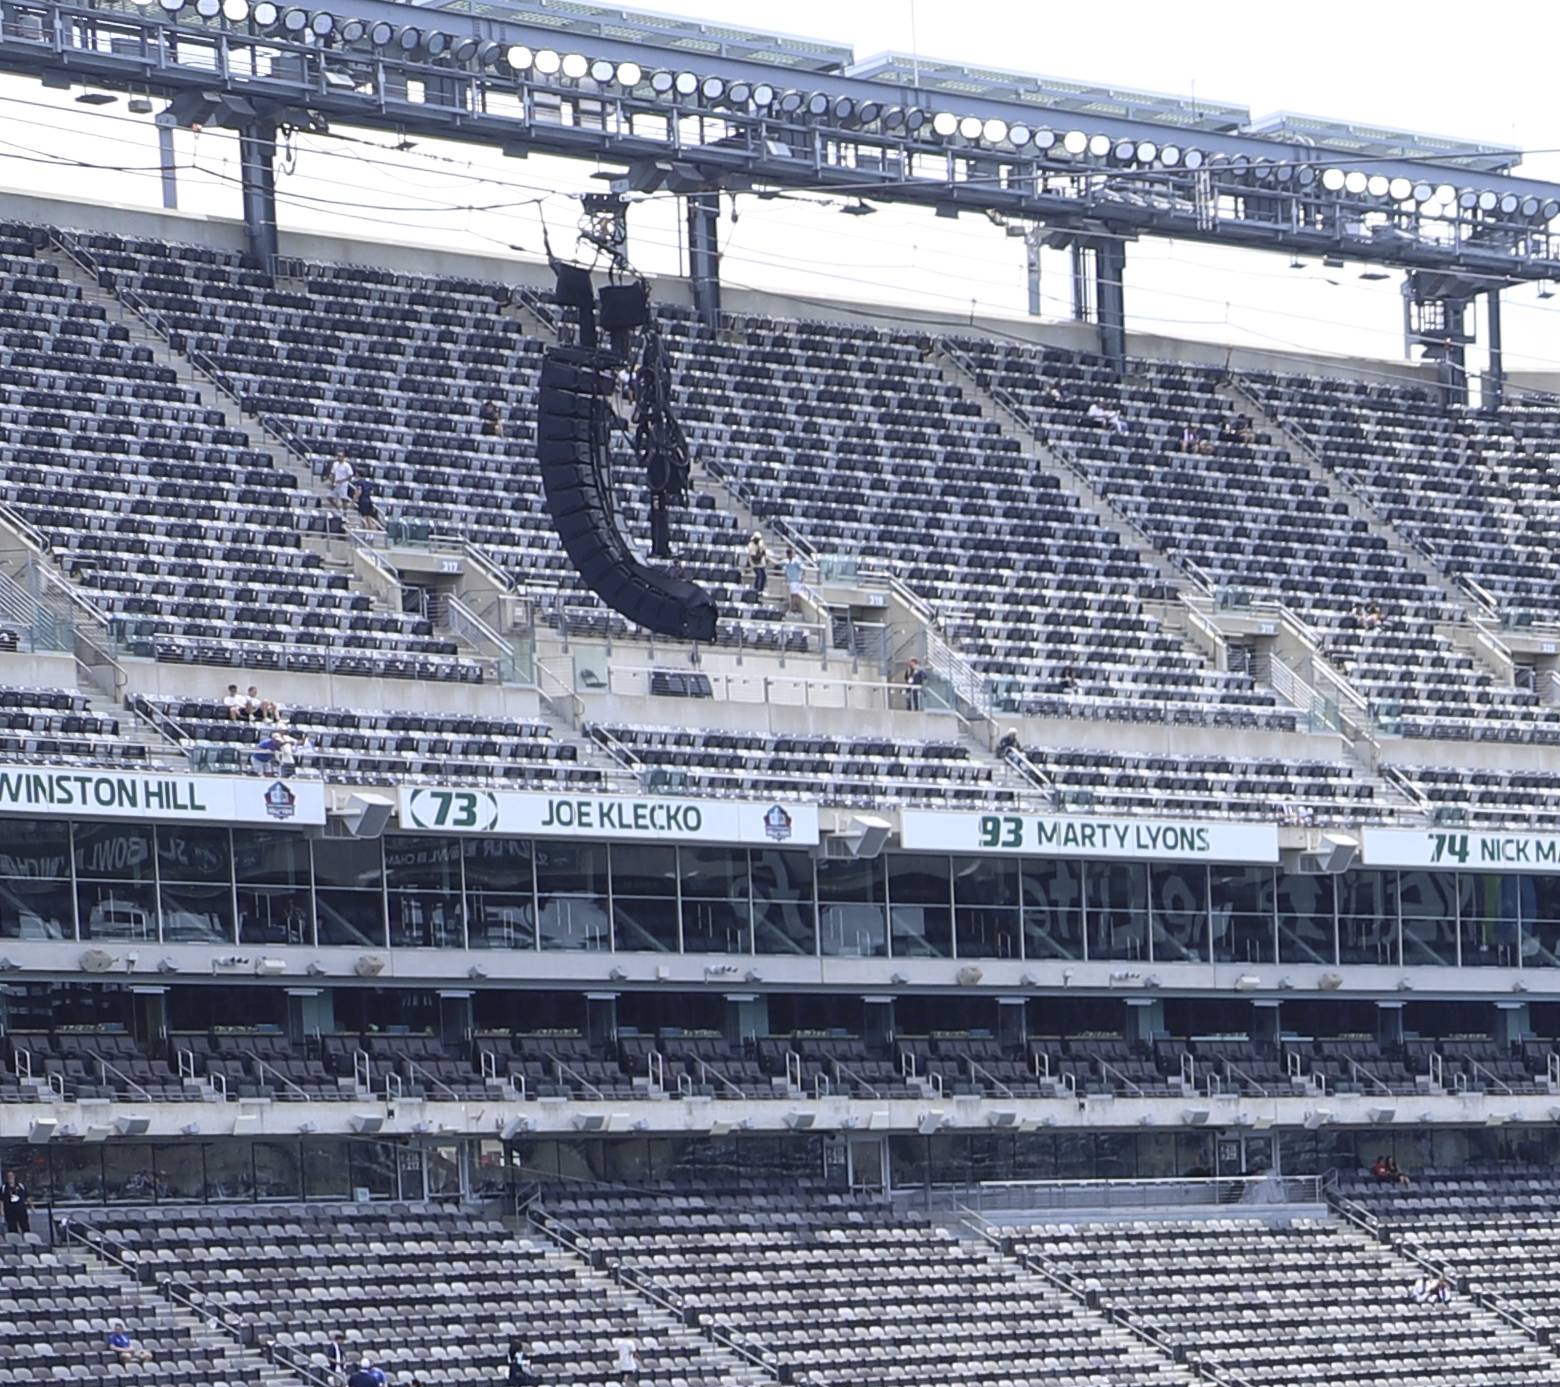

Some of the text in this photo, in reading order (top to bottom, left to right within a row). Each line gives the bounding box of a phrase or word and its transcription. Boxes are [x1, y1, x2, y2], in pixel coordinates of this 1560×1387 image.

[144, 780, 206, 811] HILL
[429, 792, 701, 832] 73 JOE KLECKO
[979, 816, 1209, 851] 93 MARTY LYONS
[1428, 834, 1469, 863] 74
[1480, 838, 1530, 861] NICK
